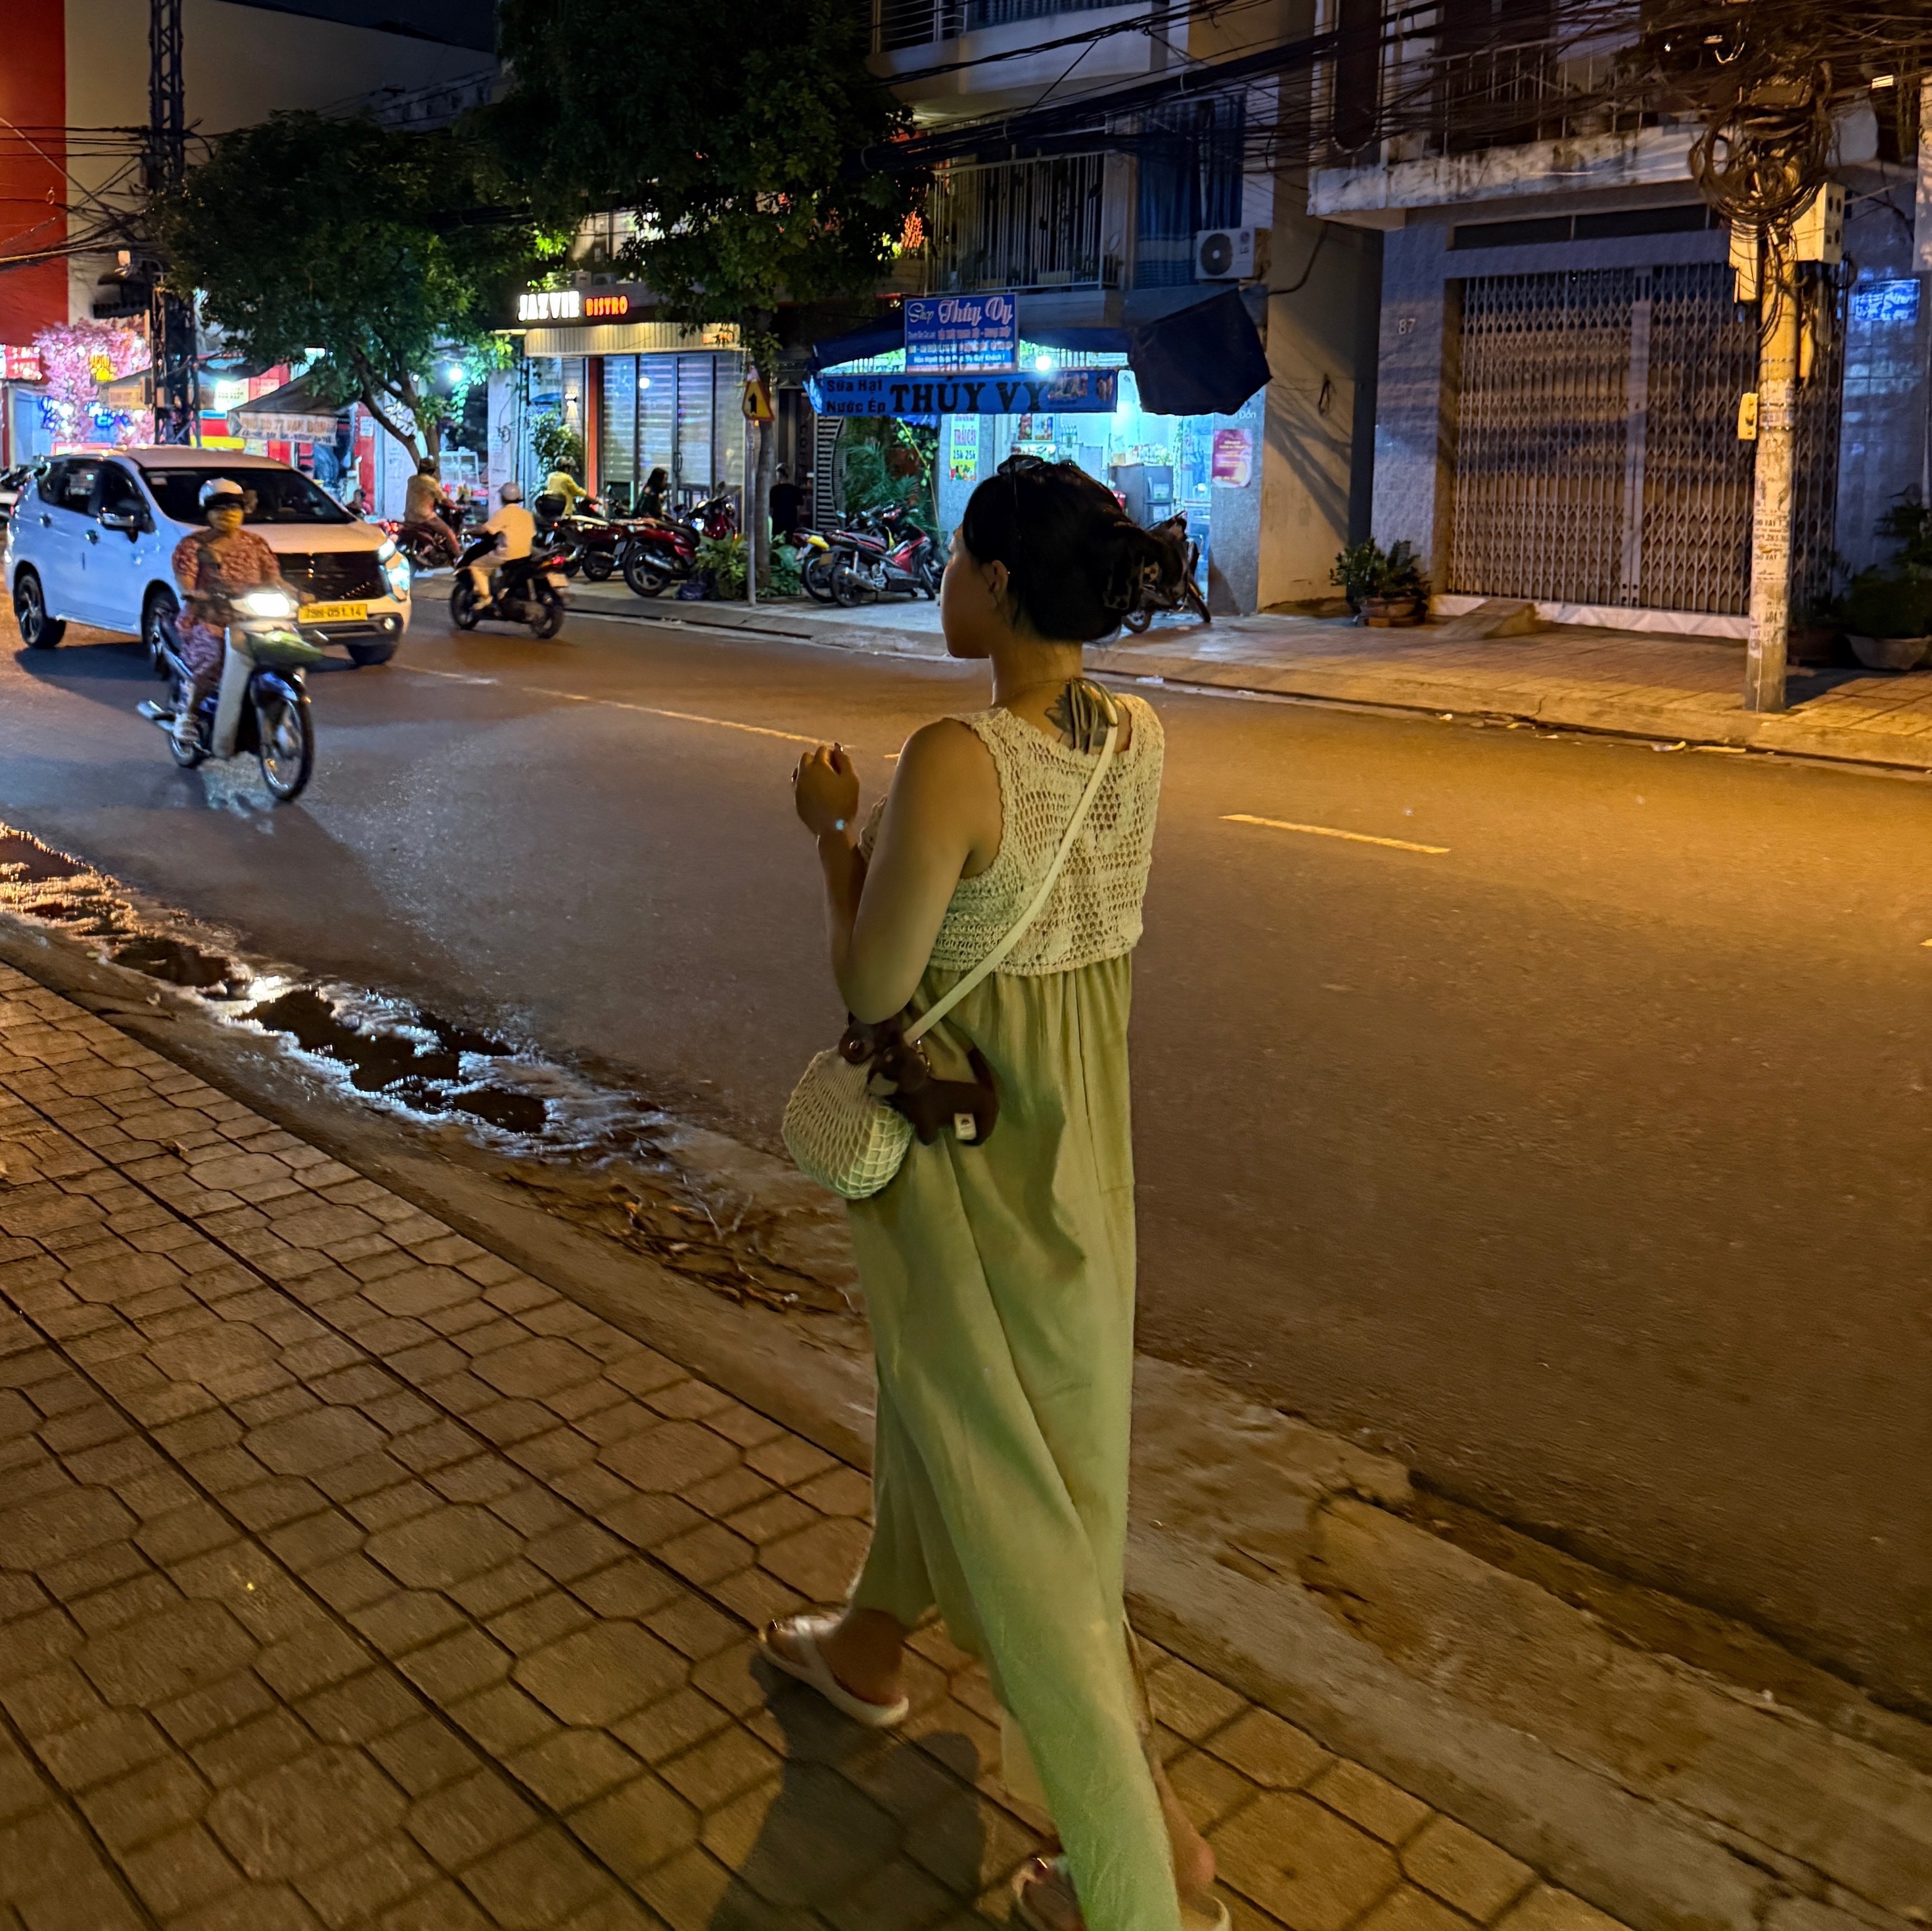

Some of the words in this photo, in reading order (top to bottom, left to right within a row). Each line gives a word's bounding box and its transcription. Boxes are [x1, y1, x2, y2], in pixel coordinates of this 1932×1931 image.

[586, 296, 628, 316] BISTRO
[908, 303, 934, 324] Shop
[1399, 319, 1415, 335] 87
[826, 399, 863, 413] Nước
[867, 398, 886, 413] Ép
[996, 381, 1048, 412] VY
